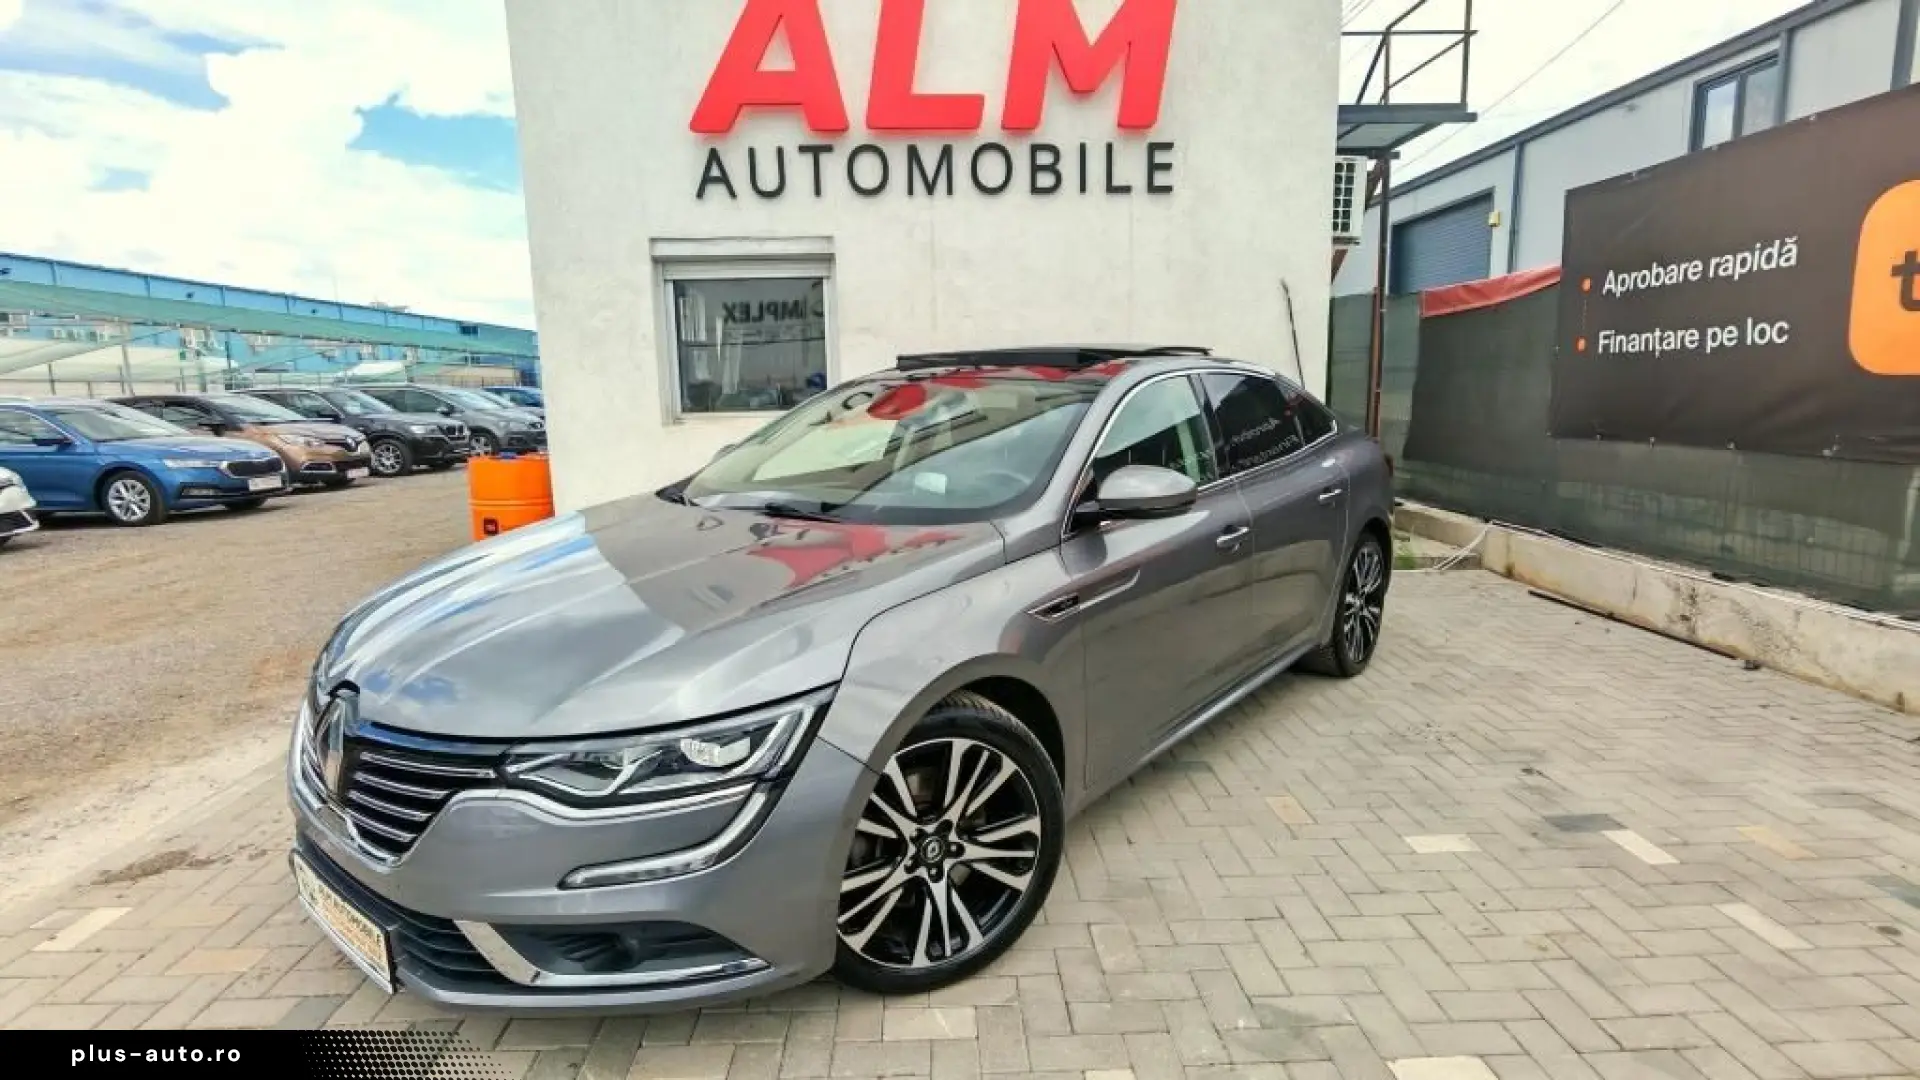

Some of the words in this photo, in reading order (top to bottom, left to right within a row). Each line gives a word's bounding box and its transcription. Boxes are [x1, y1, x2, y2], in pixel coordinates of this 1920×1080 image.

[689, 0, 1178, 133] ALM
[696, 142, 1175, 199] AUTOMOBILE
[1602, 260, 1703, 298] Aprobare
[1709, 236, 1799, 280] rapidă
[1598, 327, 1700, 358] Finanțare
[1706, 324, 1738, 353] pe
[1746, 317, 1790, 345] loc
